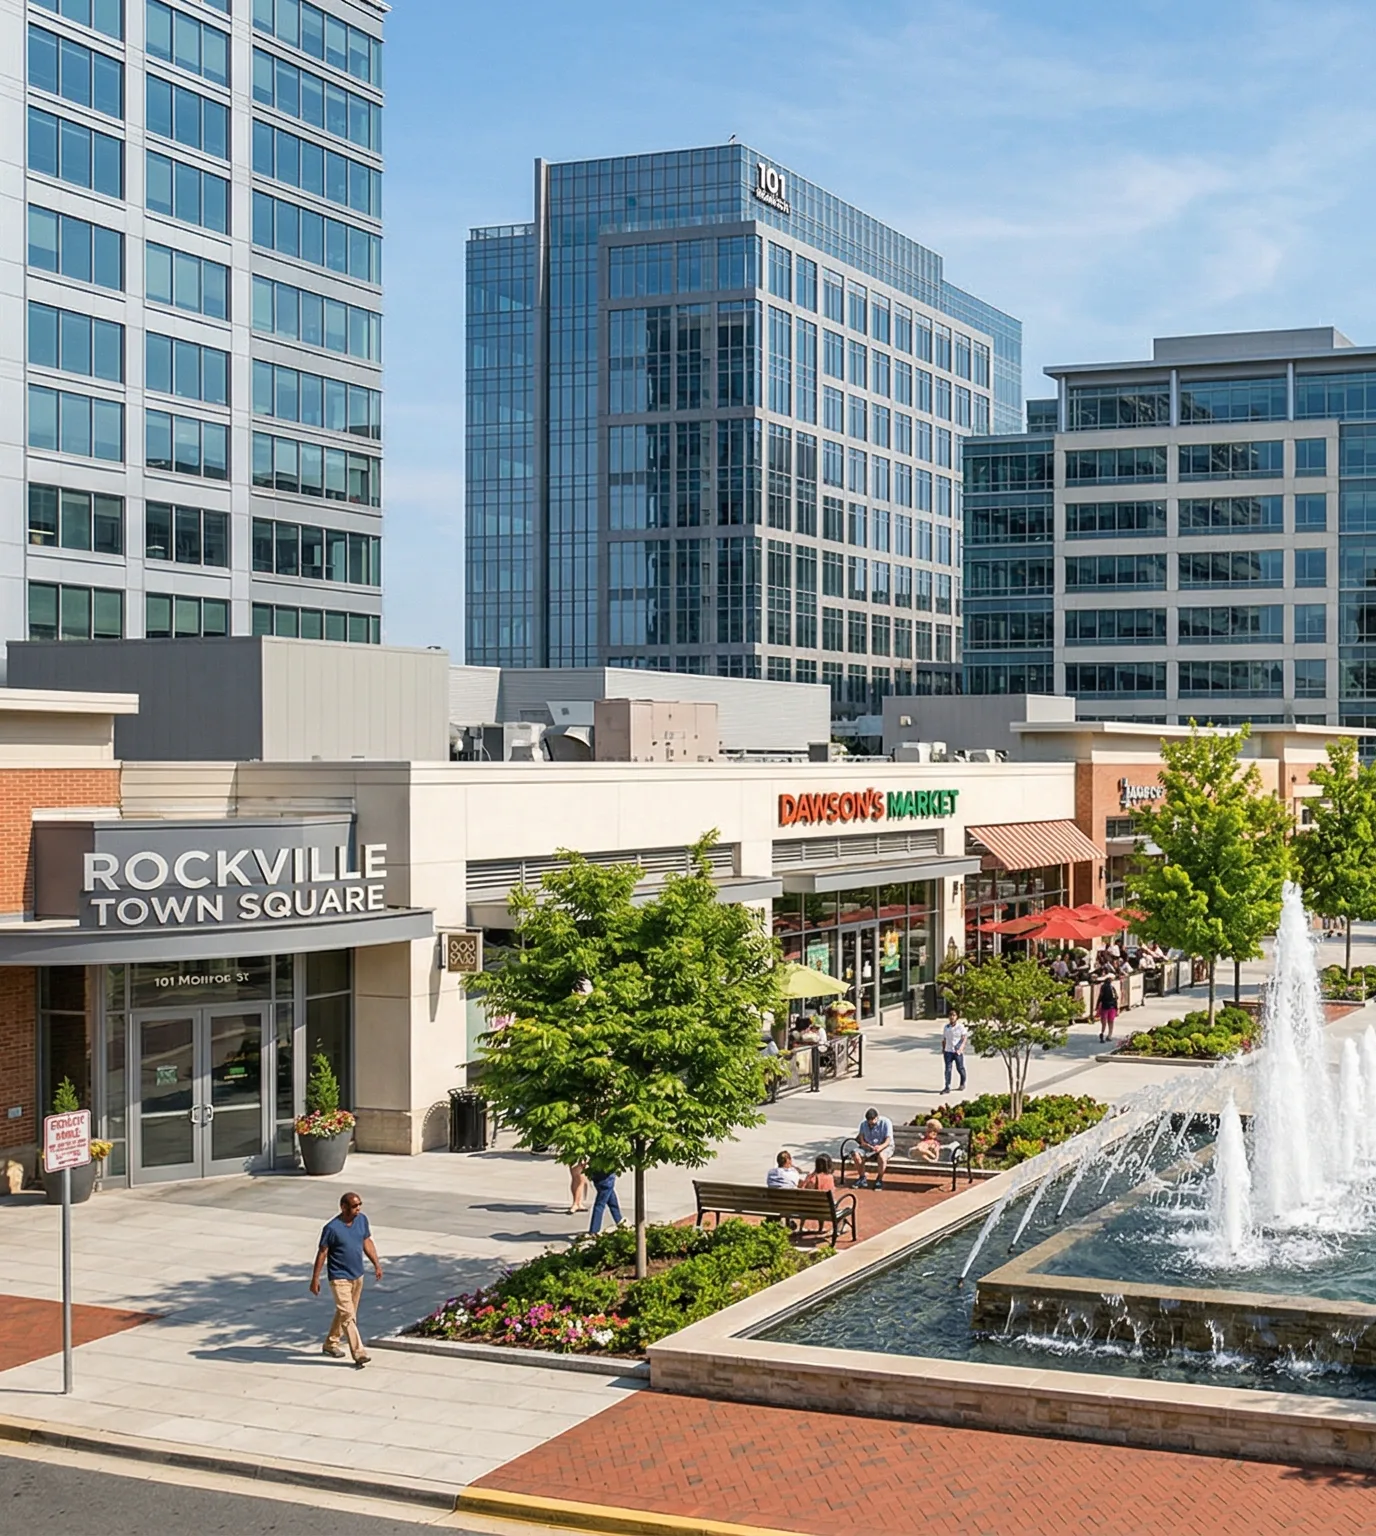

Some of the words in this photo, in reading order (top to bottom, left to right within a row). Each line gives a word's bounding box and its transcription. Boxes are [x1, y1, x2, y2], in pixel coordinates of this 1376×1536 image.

[758, 162, 785, 199] 101
[779, 787, 885, 826] DAWSON'S
[887, 790, 959, 819] MARKET
[84, 844, 387, 891] ROCKVILLE
[91, 894, 223, 926] TOWN
[239, 884, 385, 920] SQUARE
[155, 976, 175, 987] 101
